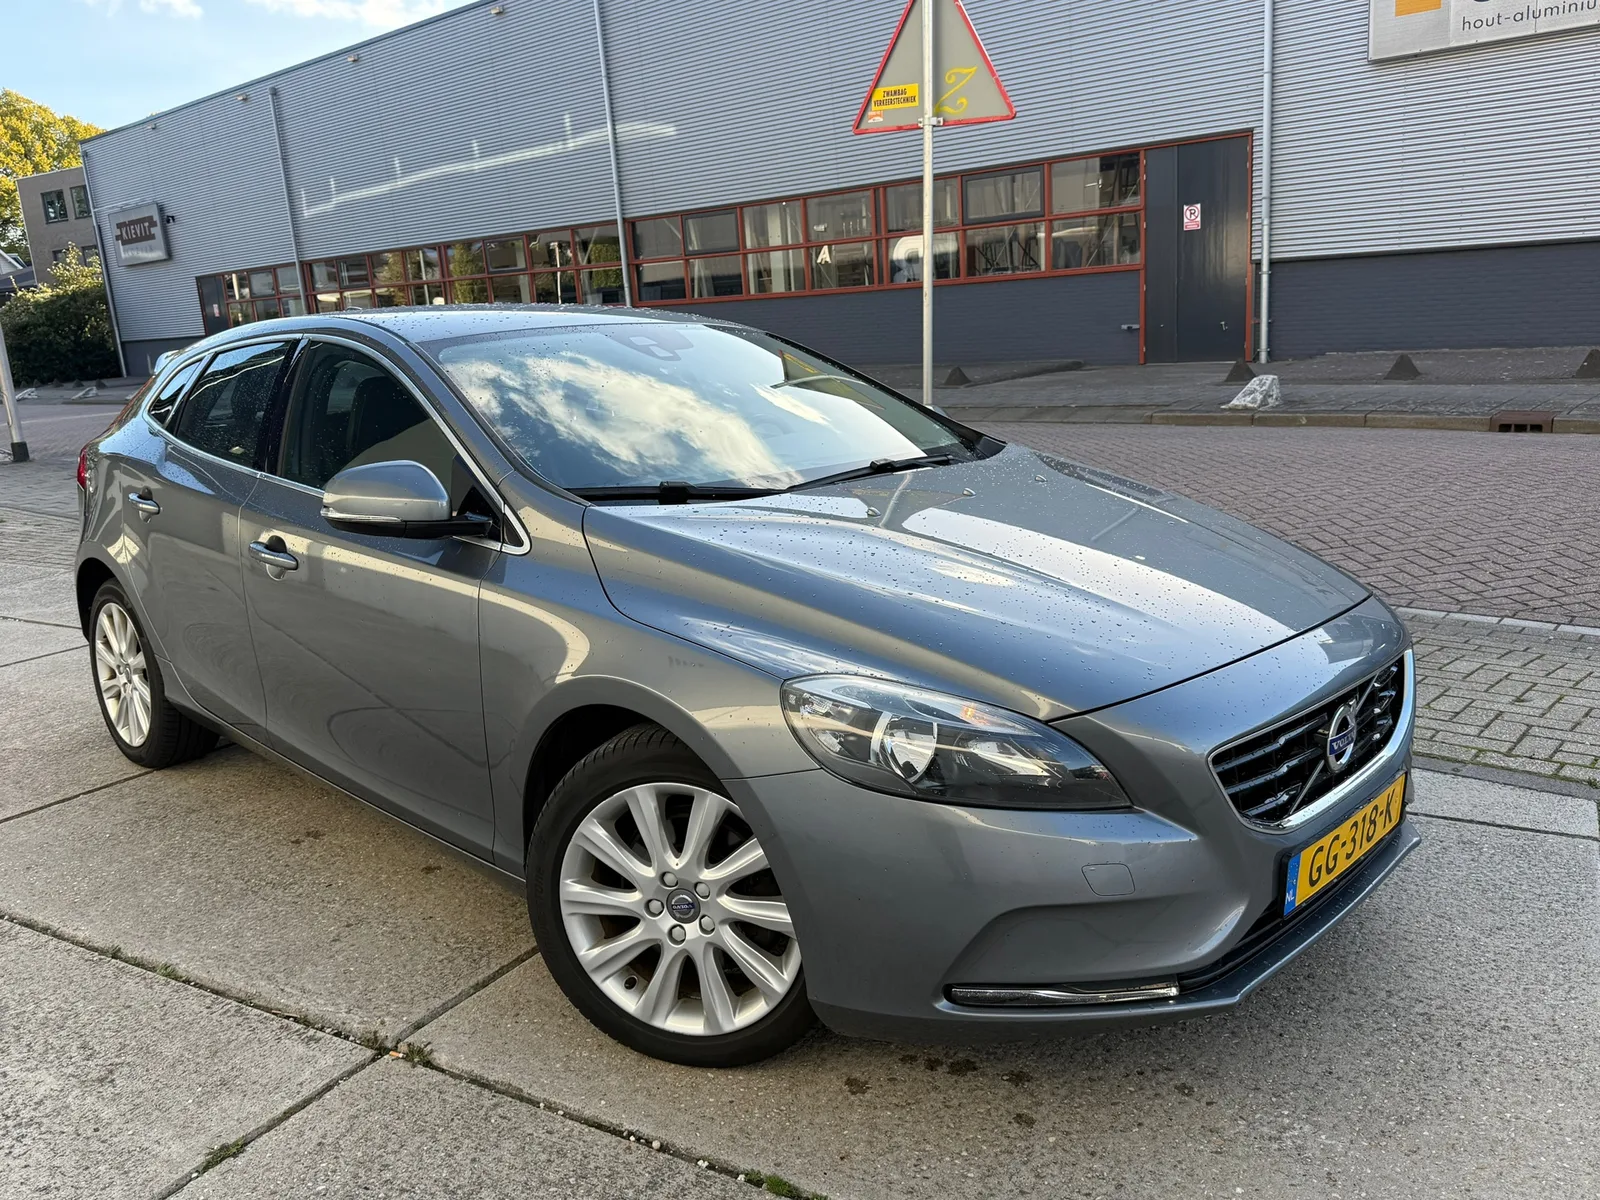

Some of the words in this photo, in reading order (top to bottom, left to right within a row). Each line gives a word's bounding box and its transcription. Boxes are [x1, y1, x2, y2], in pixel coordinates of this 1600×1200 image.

[873, 95, 917, 107] VERKEERSTECHNIEK
[882, 88, 908, 98] ZWAMBAG
[121, 222, 149, 240] KIEVIT
[1308, 788, 1395, 888] GG-318-K
[1285, 888, 1295, 905] NL
